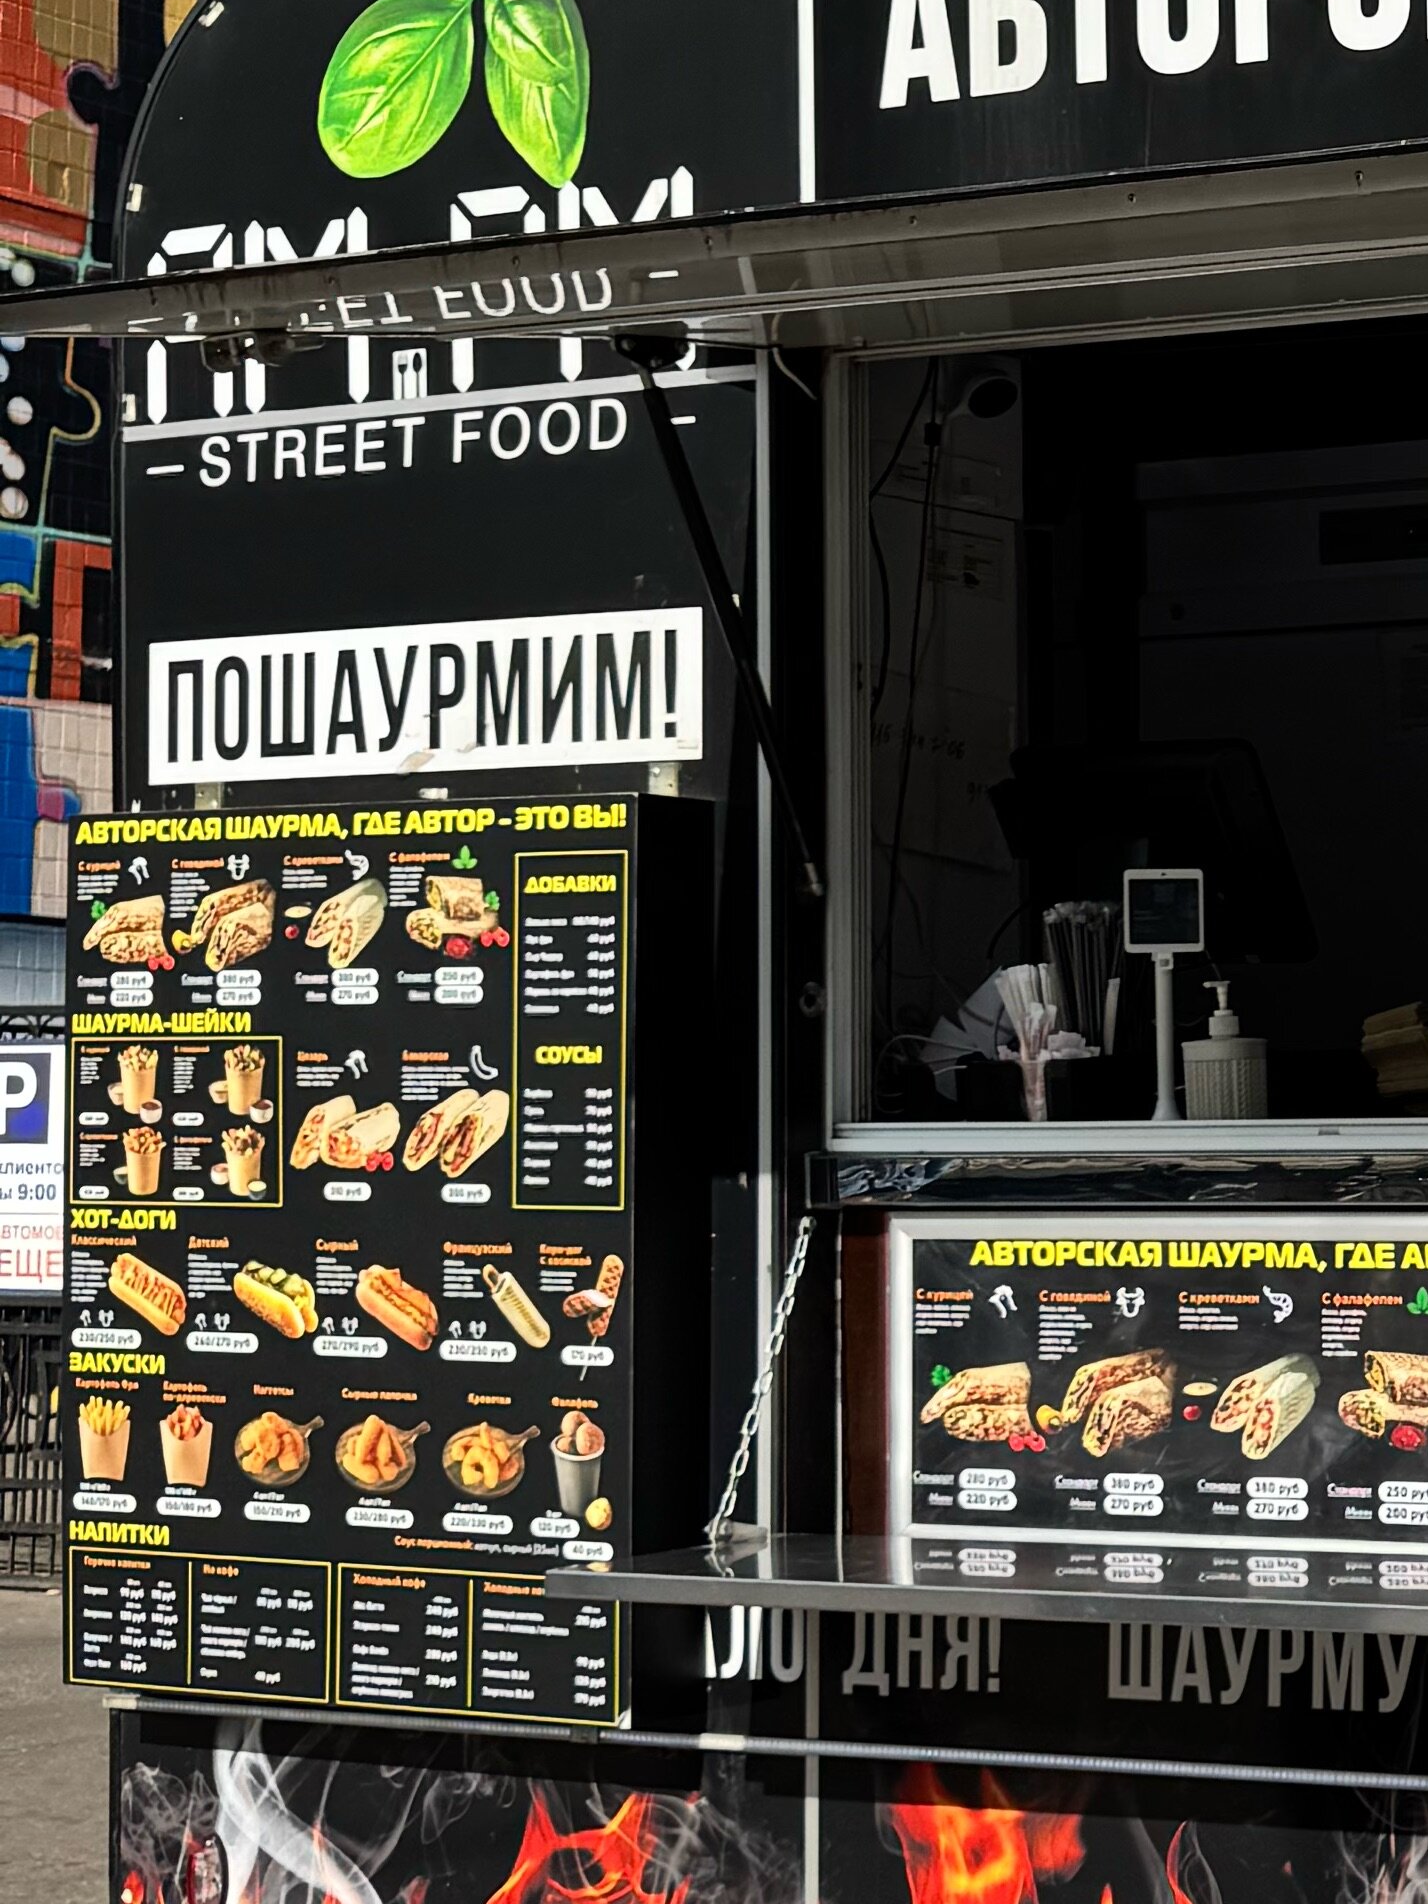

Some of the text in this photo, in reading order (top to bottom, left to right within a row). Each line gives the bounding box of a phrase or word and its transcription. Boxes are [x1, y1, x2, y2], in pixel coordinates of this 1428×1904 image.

[199, 397, 627, 486] STREET FOOD
[168, 630, 678, 763] ПОШАУРМИМ!
[75, 814, 221, 845] АВТОРСКАЯ
[226, 810, 348, 842] ШАУРМА,
[351, 811, 401, 837] ГДЕ
[403, 807, 493, 836] АВТОР
[515, 805, 576, 833] ЭТО
[578, 803, 626, 829] ВЫ!
[525, 874, 616, 895] ДОБАВКИ
[72, 1010, 251, 1034] ШАУРМА-ШЕЙКИ
[536, 1046, 602, 1065] СОУСЫ
[18, 1183, 56, 1200] 9:00
[70, 1208, 176, 1231] ХОТ-ДОГИ
[316, 1239, 359, 1253] Сырный
[443, 1241, 513, 1256] Французский
[970, 1240, 1162, 1267] АВТОРСКАЯ
[1168, 1240, 1327, 1273] ШАУРМА,
[1335, 1243, 1396, 1269] ГДЕ
[1191, 1293, 1260, 1305] креветками
[69, 1352, 165, 1375] ЗАКУСКИ
[1133, 1499, 1155, 1514] руб
[1278, 1503, 1299, 1518] руб
[69, 1522, 170, 1548] НАПИТКИ
[842, 1610, 1001, 1695] ДНЯ!
